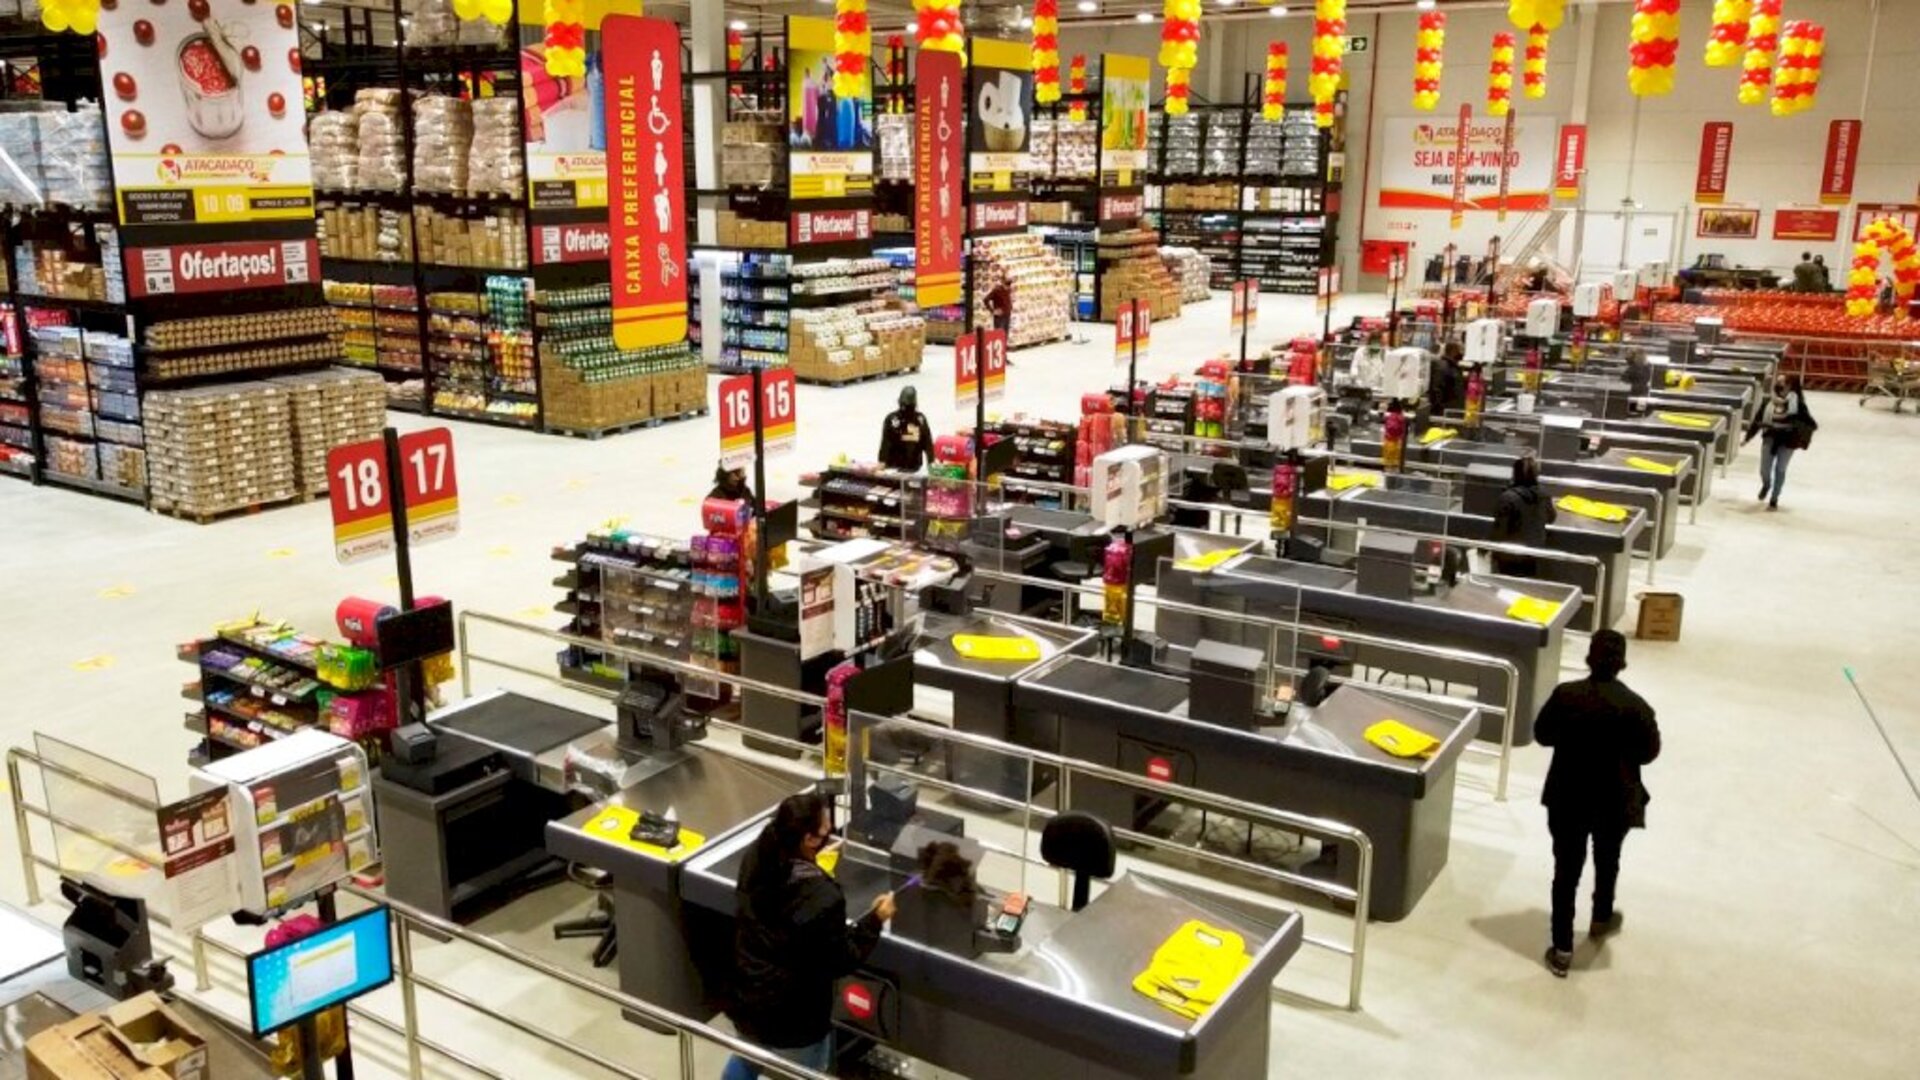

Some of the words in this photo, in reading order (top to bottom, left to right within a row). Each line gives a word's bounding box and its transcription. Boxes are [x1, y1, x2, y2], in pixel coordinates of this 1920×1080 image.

[184, 159, 254, 173] ATACADAÇO
[619, 74, 643, 226] PREFERENCIAL
[920, 97, 931, 213] PREFERENCIAL
[1414, 151, 1443, 167] SEJA
[1447, 151, 1520, 167] BM-VINO
[920, 221, 931, 266] CAIXA
[179, 247, 276, 283] Ofertaços!
[626, 234, 641, 294] CAIXA
[1120, 311, 1133, 338] 12
[1140, 308, 1150, 335] 11
[960, 344, 977, 377] 14
[986, 339, 1002, 370] 13
[725, 388, 750, 428] 16
[765, 379, 791, 419] 15
[338, 458, 382, 511] 18
[409, 443, 447, 494] 17
